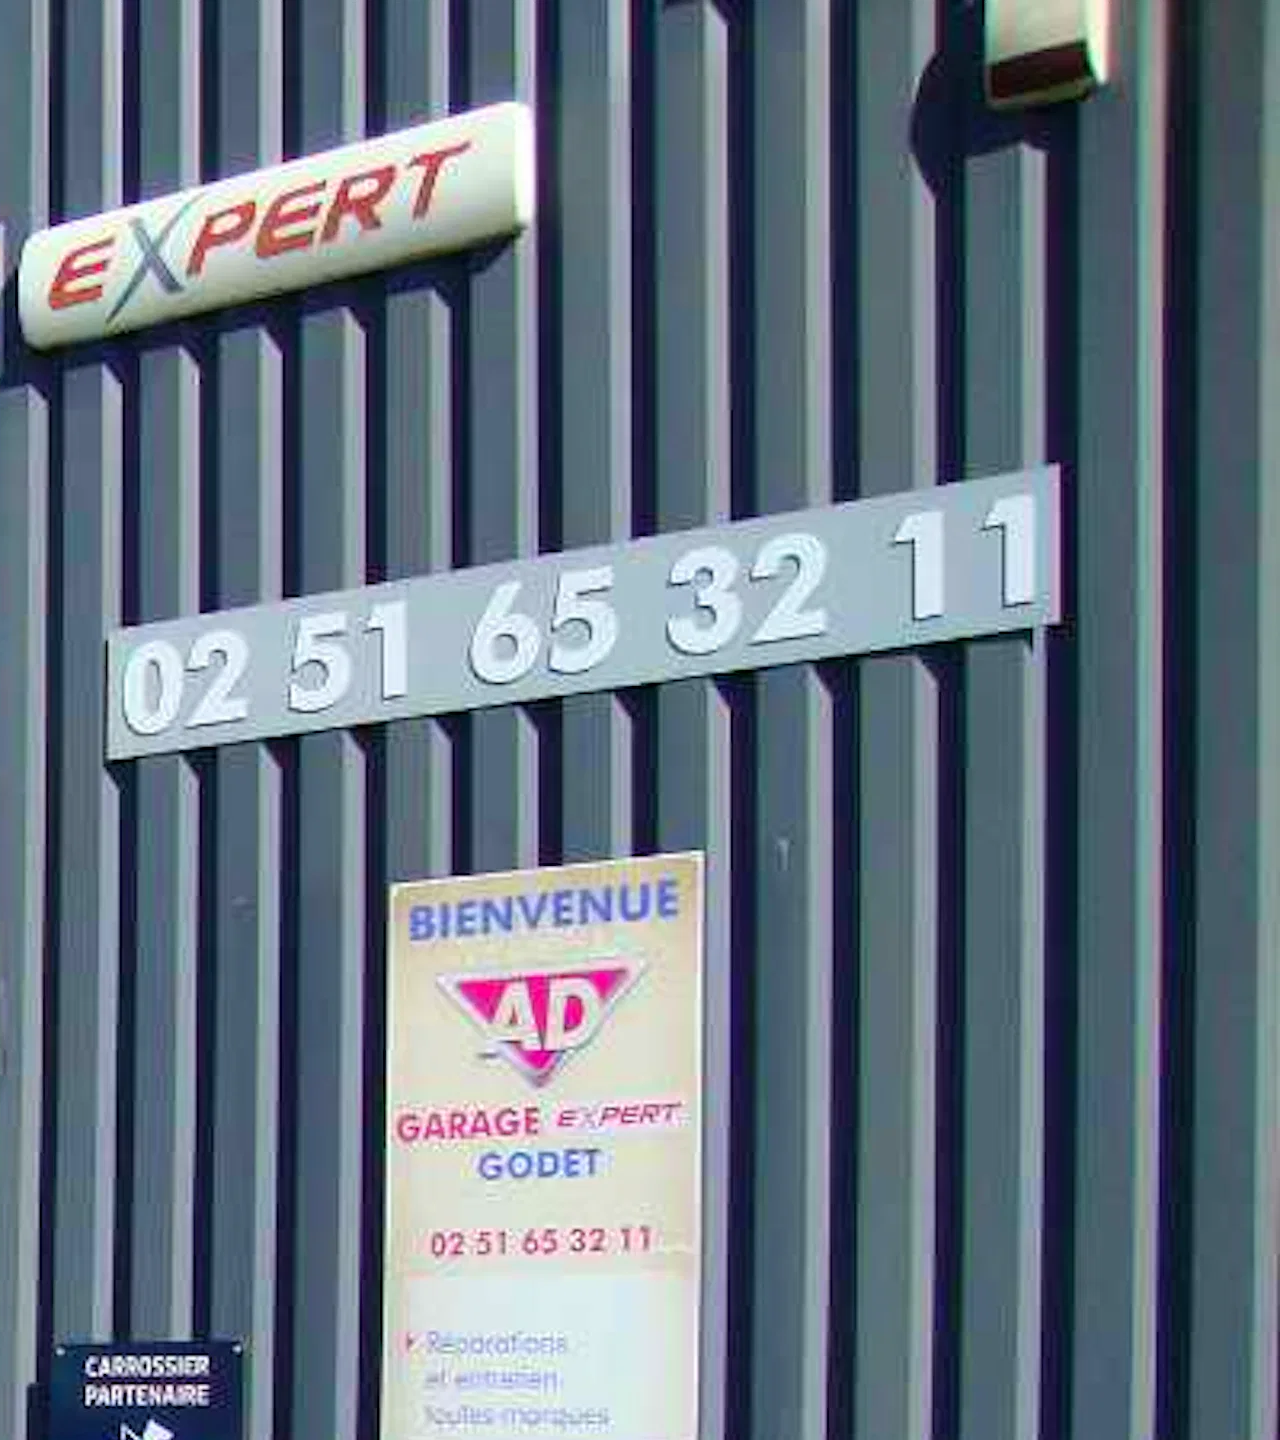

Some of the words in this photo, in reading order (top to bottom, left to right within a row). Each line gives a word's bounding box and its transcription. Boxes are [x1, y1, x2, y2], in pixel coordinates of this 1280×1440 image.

[122, 627, 251, 735] 02
[286, 599, 410, 713] 51
[469, 563, 622, 684] 65
[664, 531, 830, 655] 32
[888, 492, 1038, 621] 11
[408, 878, 680, 942] BIENVENUE
[490, 976, 602, 1052] AD
[396, 1107, 541, 1143] GARAGE
[478, 1149, 603, 1181] GODET
[430, 1231, 466, 1258] 02
[476, 1230, 509, 1257] 51
[522, 1228, 559, 1255] 65
[569, 1227, 606, 1253] 32
[621, 1226, 653, 1252] 11
[84, 1355, 212, 1379] CARROSSIER
[83, 1383, 212, 1407] PARTENAIRE
